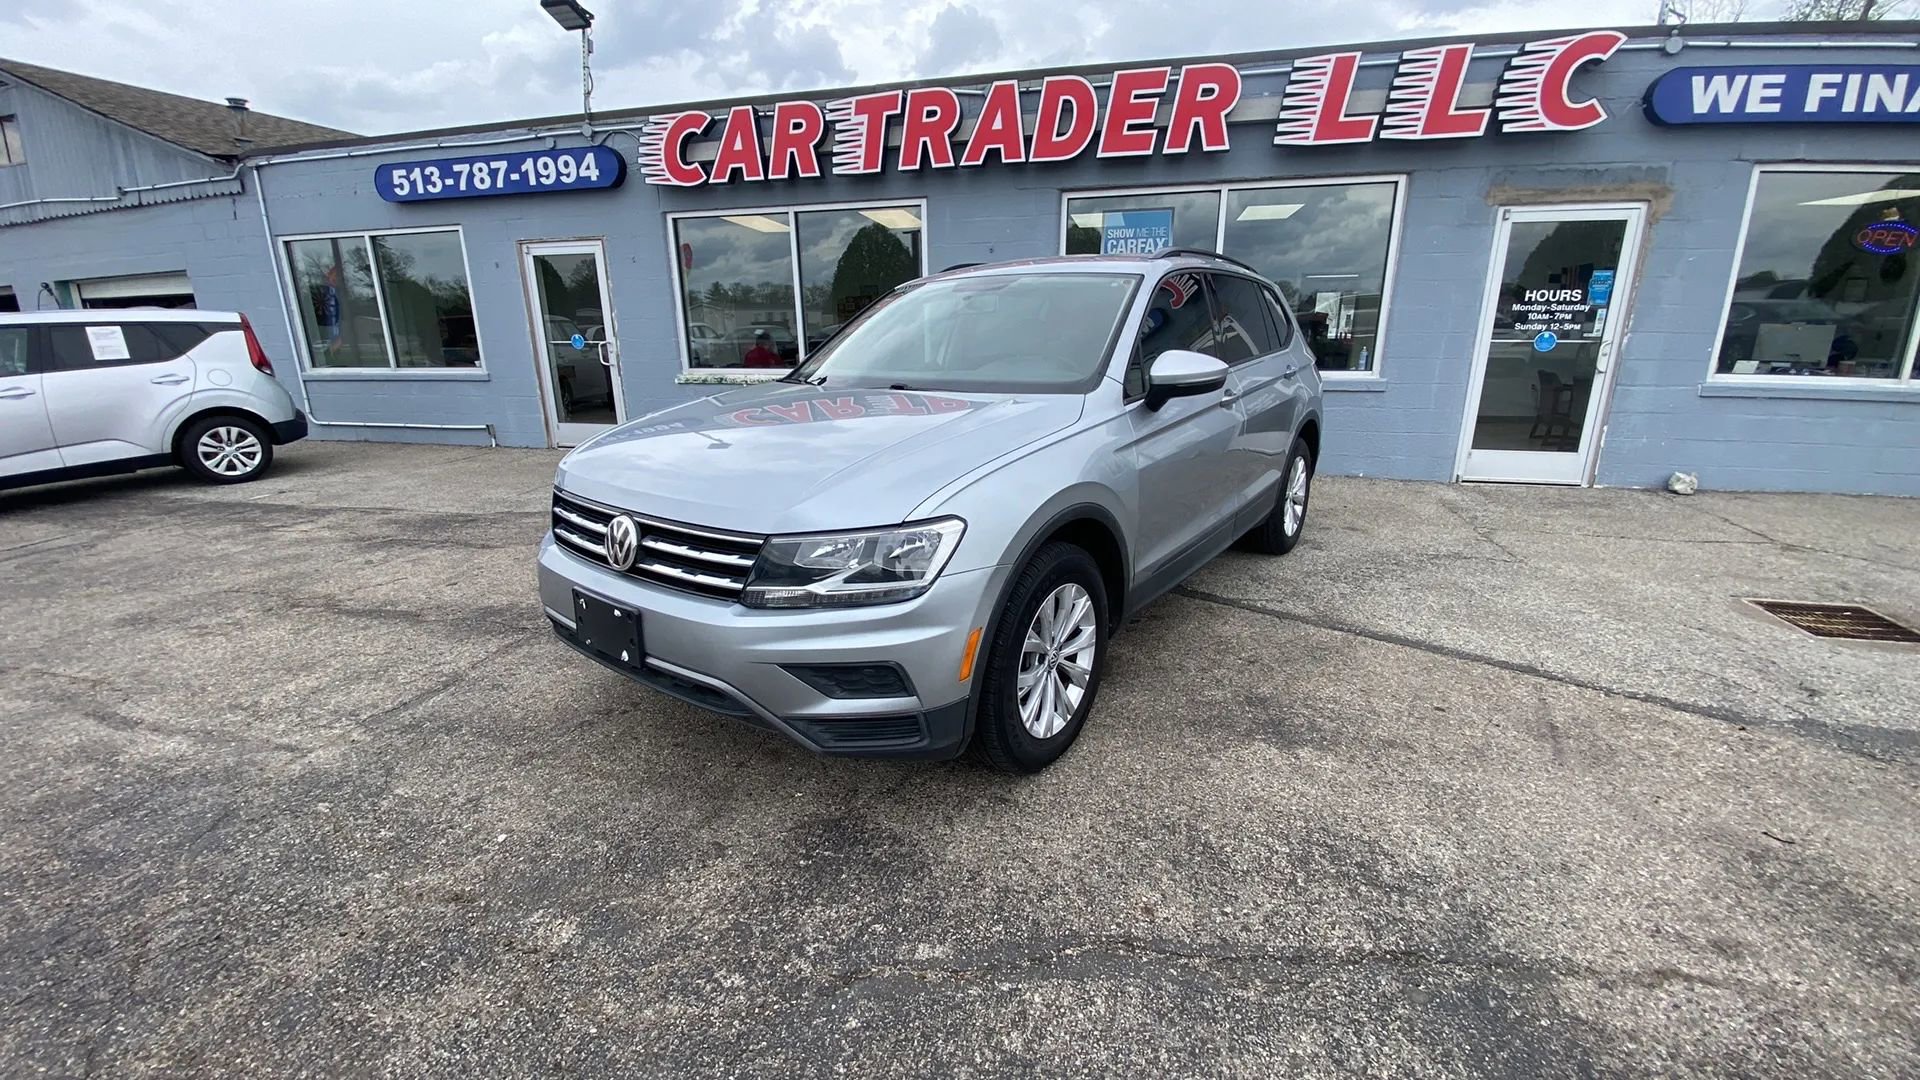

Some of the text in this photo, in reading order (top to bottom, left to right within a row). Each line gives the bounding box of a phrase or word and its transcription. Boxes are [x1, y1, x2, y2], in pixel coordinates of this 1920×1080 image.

[1691, 74, 1786, 114] WE
[638, 100, 825, 187] CAR
[826, 61, 1243, 174] TRADER
[392, 152, 599, 196] 513-787-1994
[1107, 226, 1167, 239] SHOW ME THE
[1857, 228, 1918, 247] OPEN
[1107, 237, 1168, 255] CARFAX
[1524, 289, 1582, 302] HOURS
[1512, 303, 1591, 312] Monday-Saturday
[1514, 323, 1548, 331] Sunday
